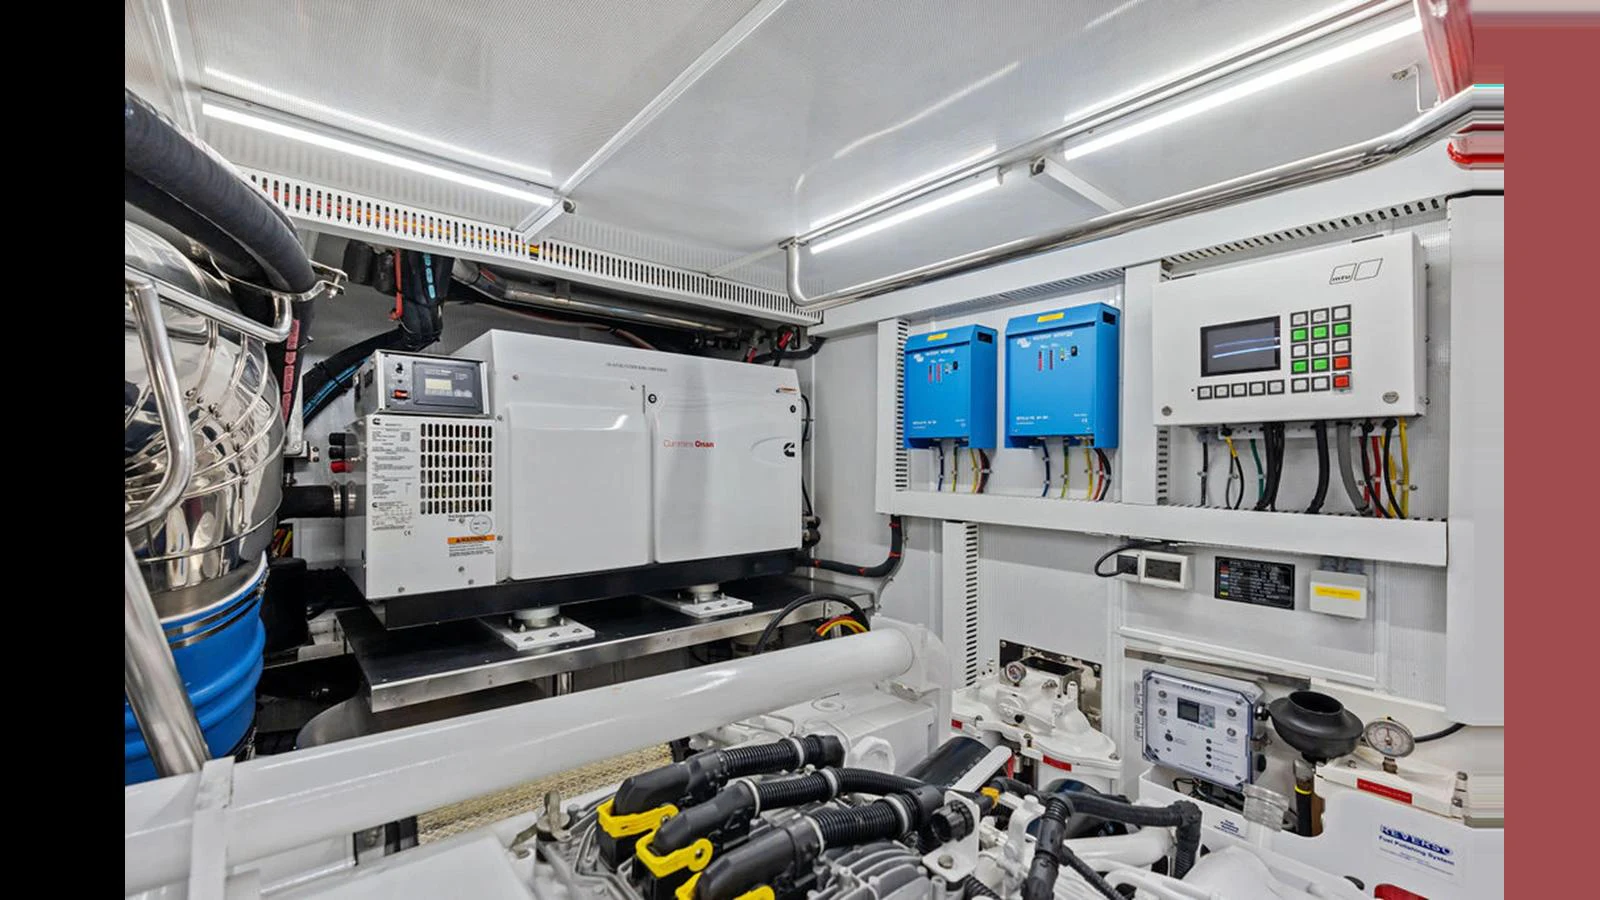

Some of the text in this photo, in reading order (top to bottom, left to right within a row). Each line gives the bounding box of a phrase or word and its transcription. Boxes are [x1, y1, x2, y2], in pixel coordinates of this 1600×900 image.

[695, 440, 715, 448] Onan
[1378, 835, 1393, 845] Fuel
[1394, 841, 1426, 857] Polishing
[1427, 852, 1456, 866] System
[1380, 824, 1453, 856] REVERSO
